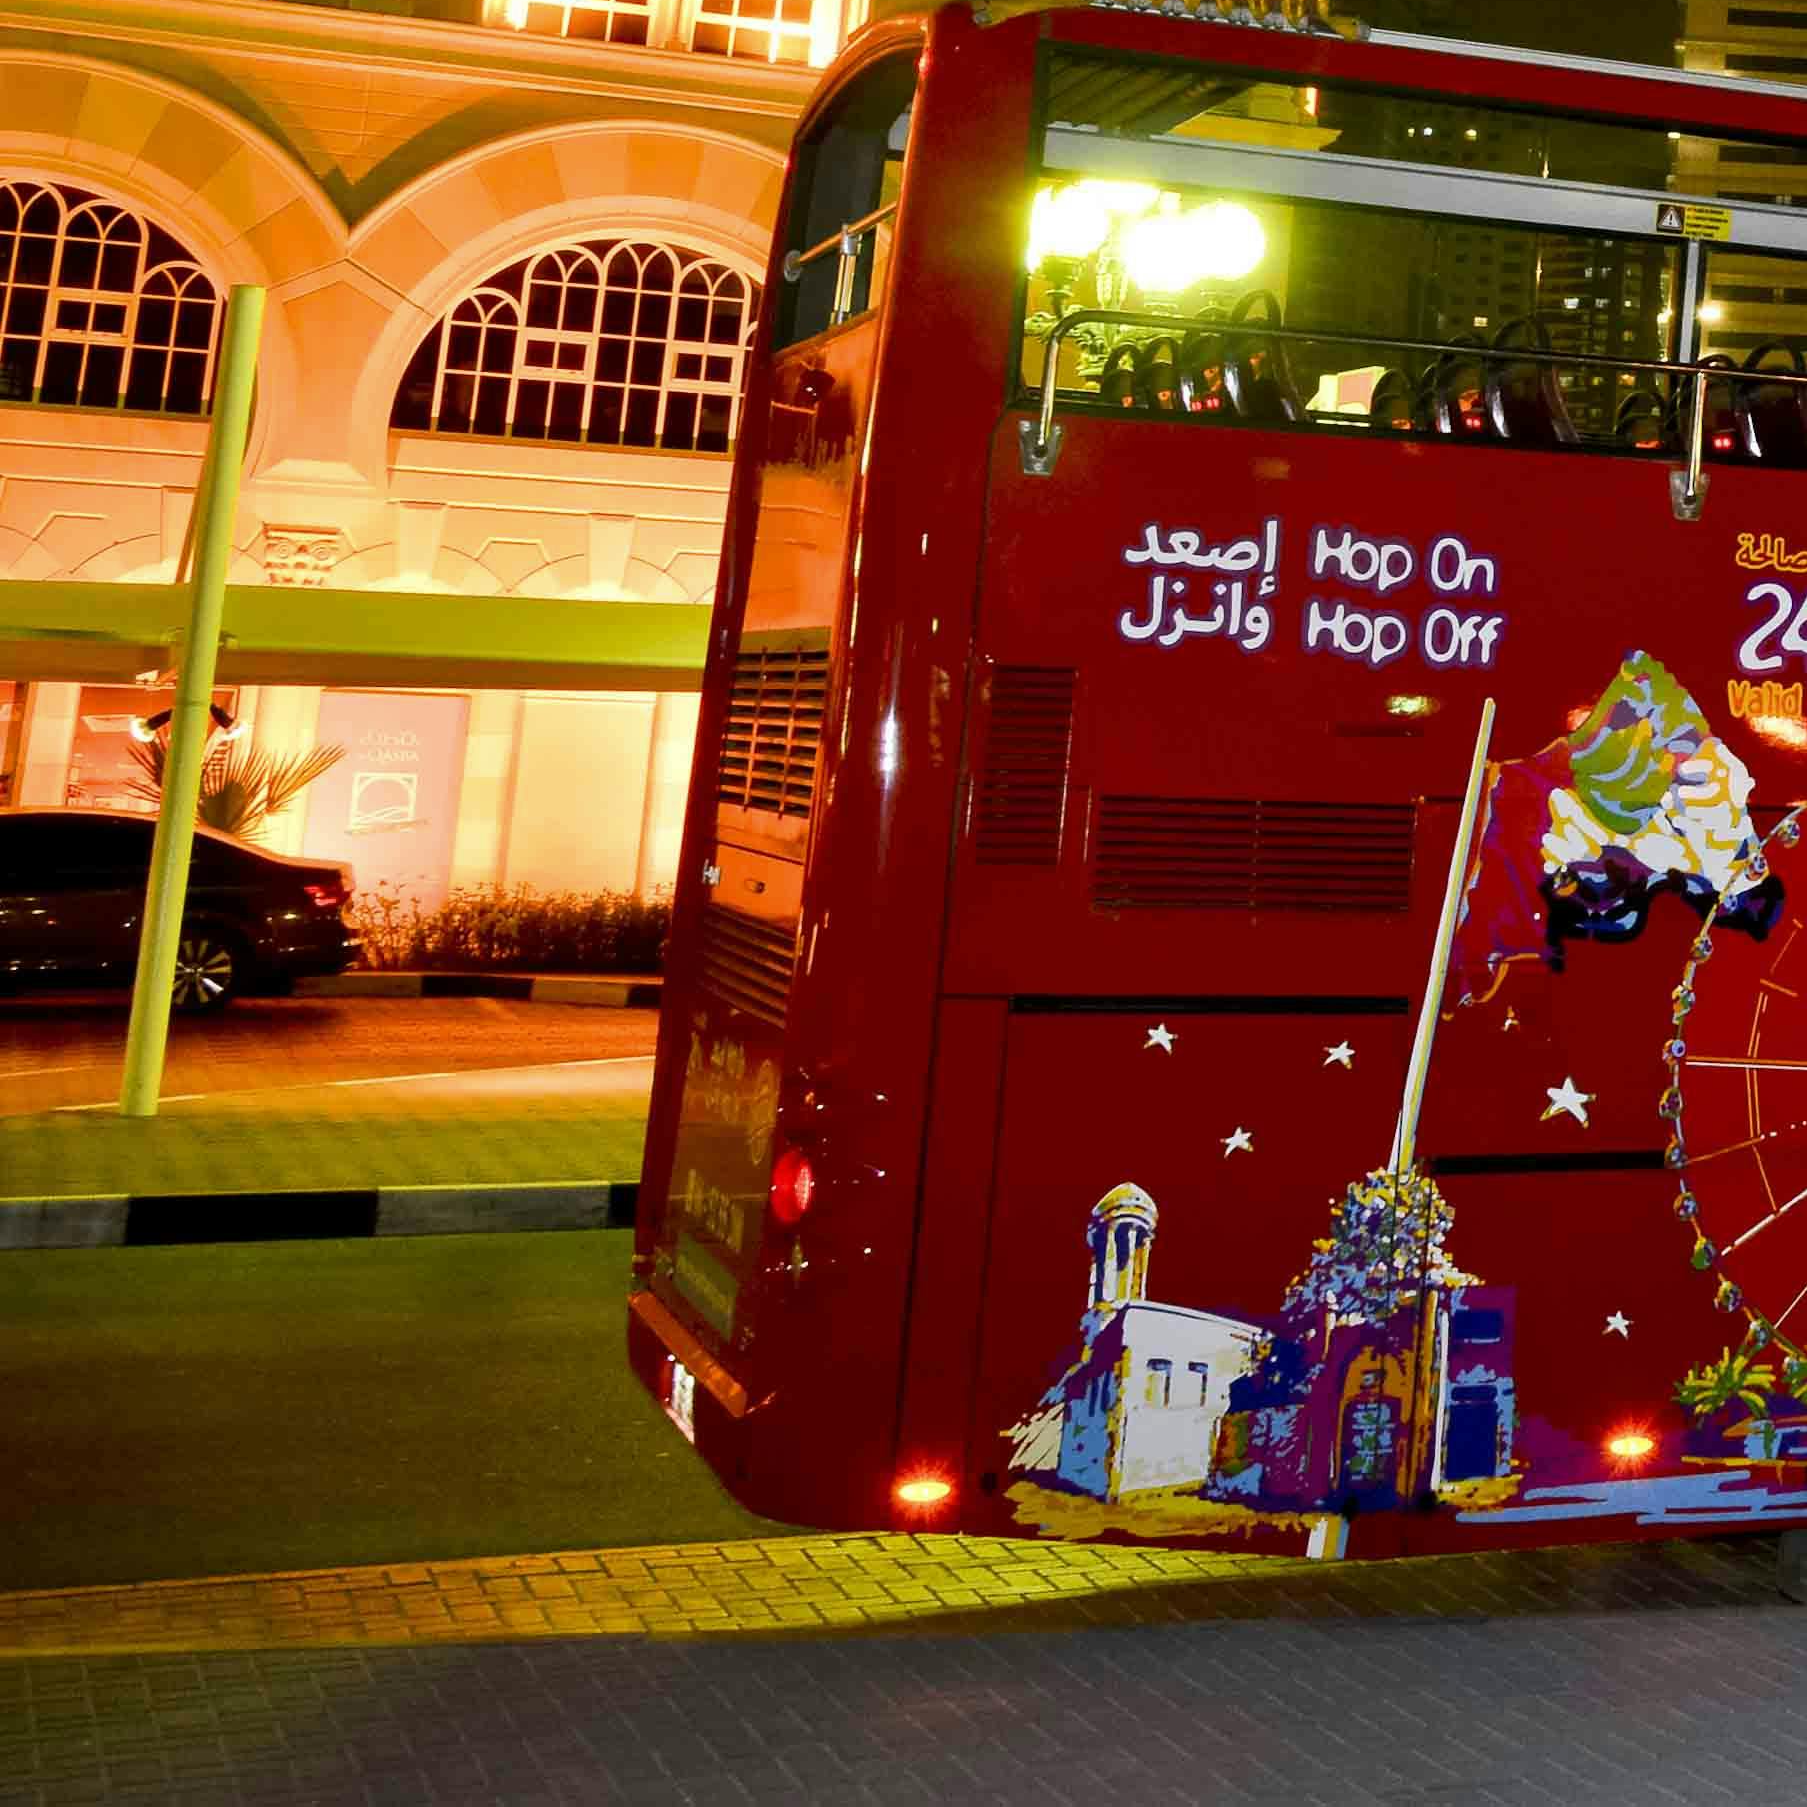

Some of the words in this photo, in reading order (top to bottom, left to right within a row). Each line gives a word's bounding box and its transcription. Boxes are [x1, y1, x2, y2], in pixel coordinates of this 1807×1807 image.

[1125, 520, 1278, 595] إصعد
[1314, 529, 1412, 591] Hop
[1431, 538, 1495, 592] On
[1120, 576, 1271, 650] وانزل
[1308, 602, 1407, 663] Hop
[1425, 608, 1503, 663] Off
[1728, 679, 1802, 718] Valid
